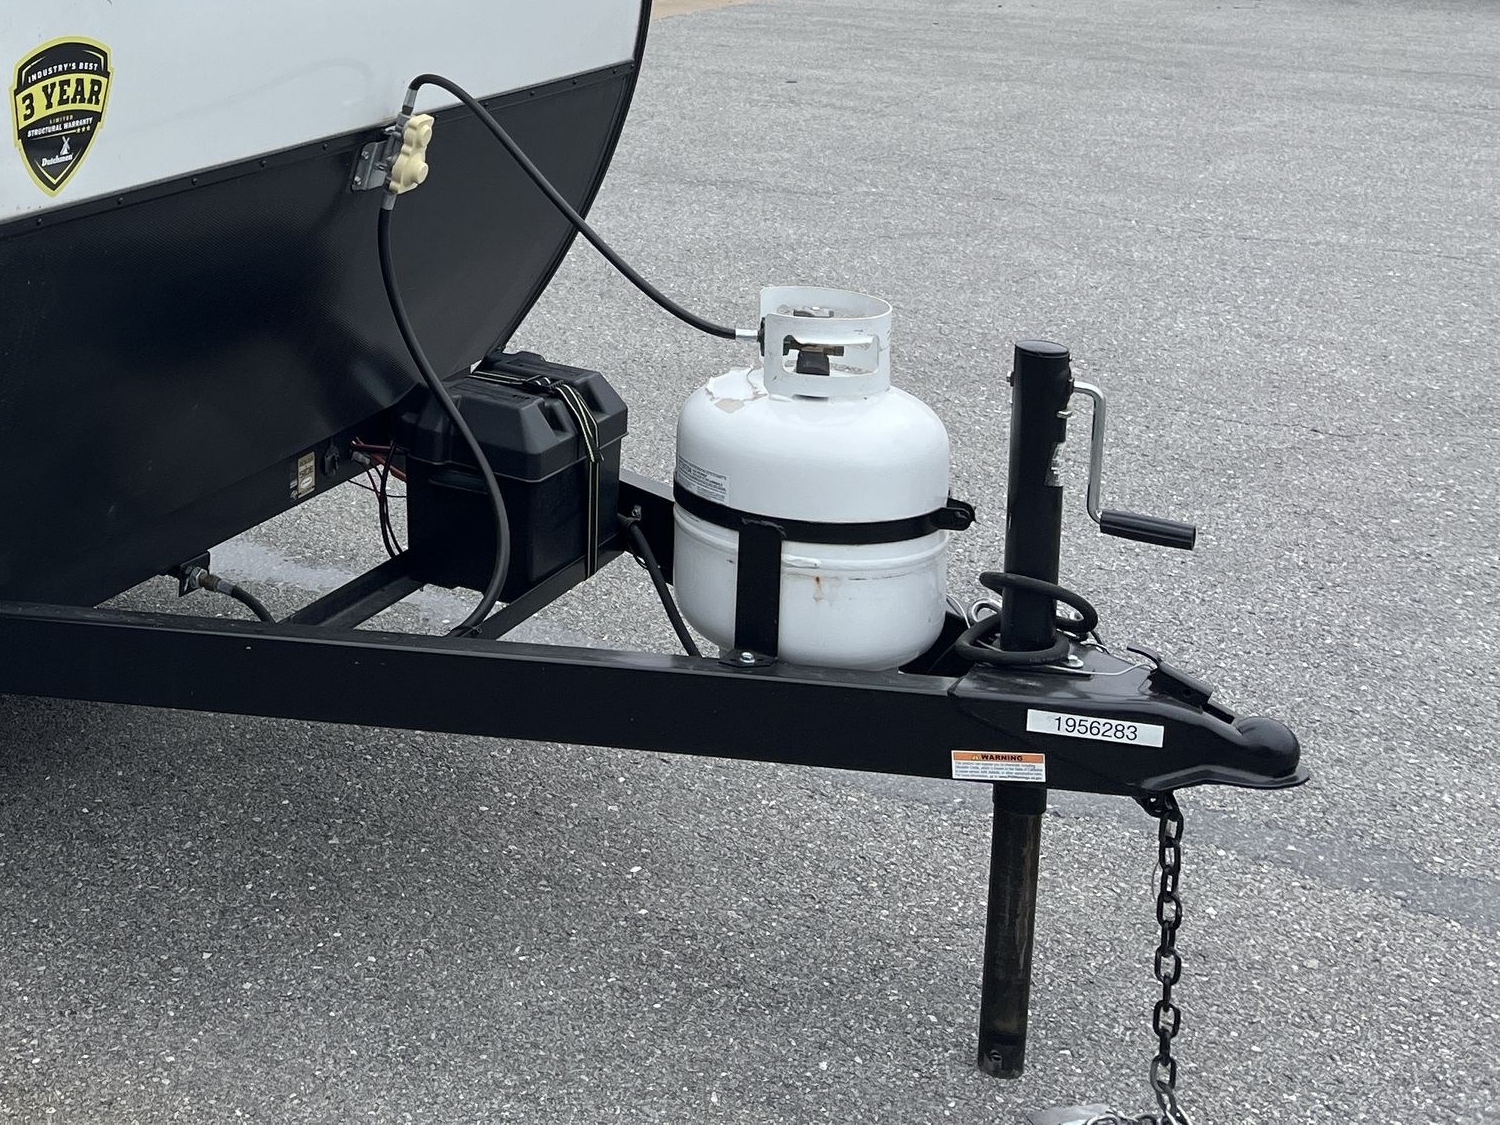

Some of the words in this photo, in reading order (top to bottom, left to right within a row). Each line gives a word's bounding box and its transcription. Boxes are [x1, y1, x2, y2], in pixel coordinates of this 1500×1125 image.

[28, 62, 76, 83] INDUSTRY'S
[78, 62, 98, 71] BEST
[22, 92, 35, 121] 3
[42, 78, 103, 110] YEAR
[27, 124, 62, 138] STRUCTURAL
[63, 117, 93, 130] WARRANTY
[49, 115, 74, 124] LIMITED
[41, 153, 73, 167] Dutchmen
[1054, 716, 1138, 741] 1956283
[980, 753, 1023, 762] WARNING
